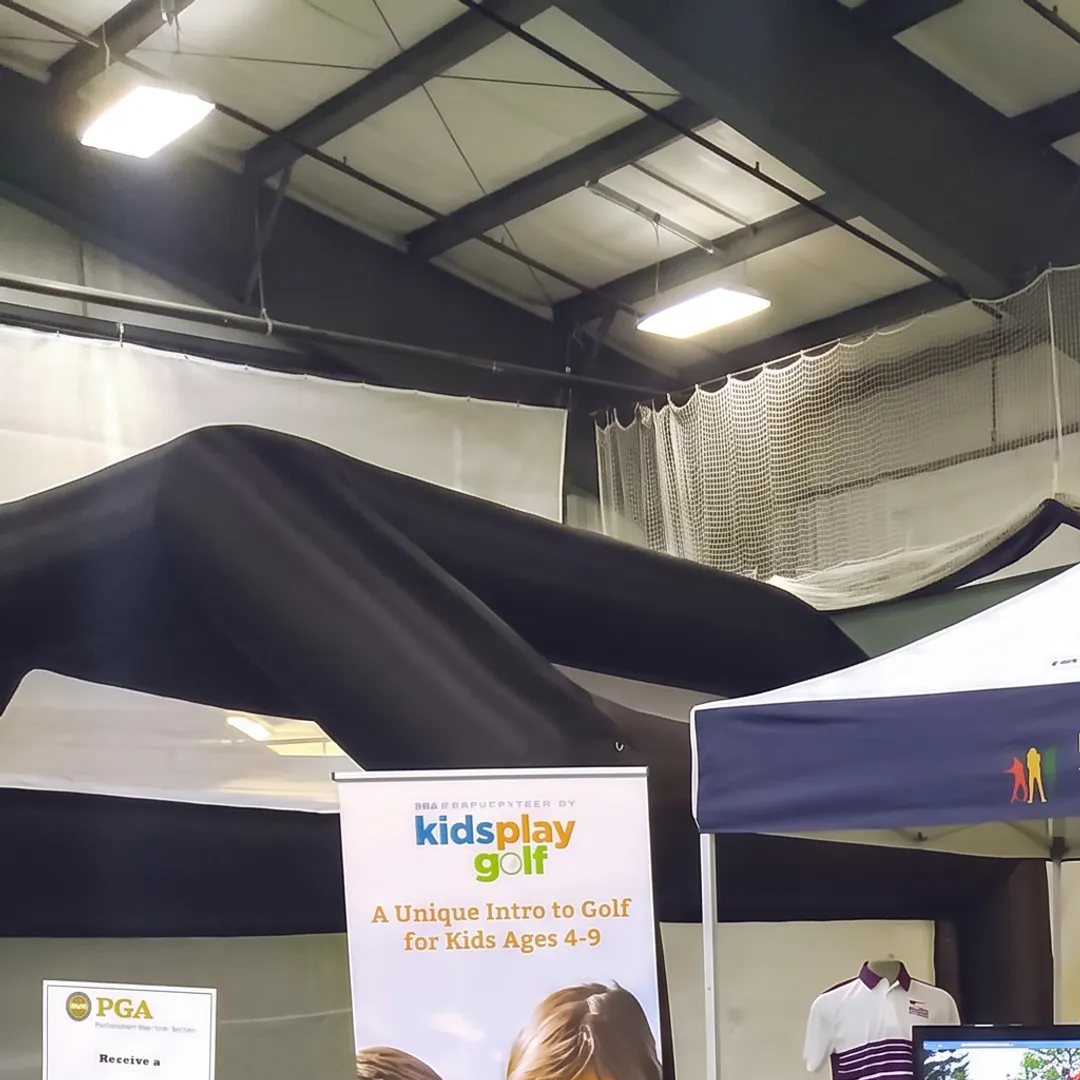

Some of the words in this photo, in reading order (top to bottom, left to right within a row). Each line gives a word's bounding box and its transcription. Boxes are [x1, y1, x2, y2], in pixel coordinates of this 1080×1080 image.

[414, 813, 576, 851] kidsplay
[473, 845, 549, 883] golf
[371, 905, 389, 924] A
[395, 903, 480, 927] Unique
[486, 902, 546, 921] Intro
[552, 900, 575, 919] to
[580, 898, 633, 919] Golf
[403, 931, 439, 952] for
[445, 930, 497, 951] Kids
[502, 931, 558, 955] Ages
[563, 928, 602, 948] 4-9
[96, 997, 154, 1019] PGA
[99, 1053, 150, 1066] Receive
[153, 1058, 161, 1066] a
